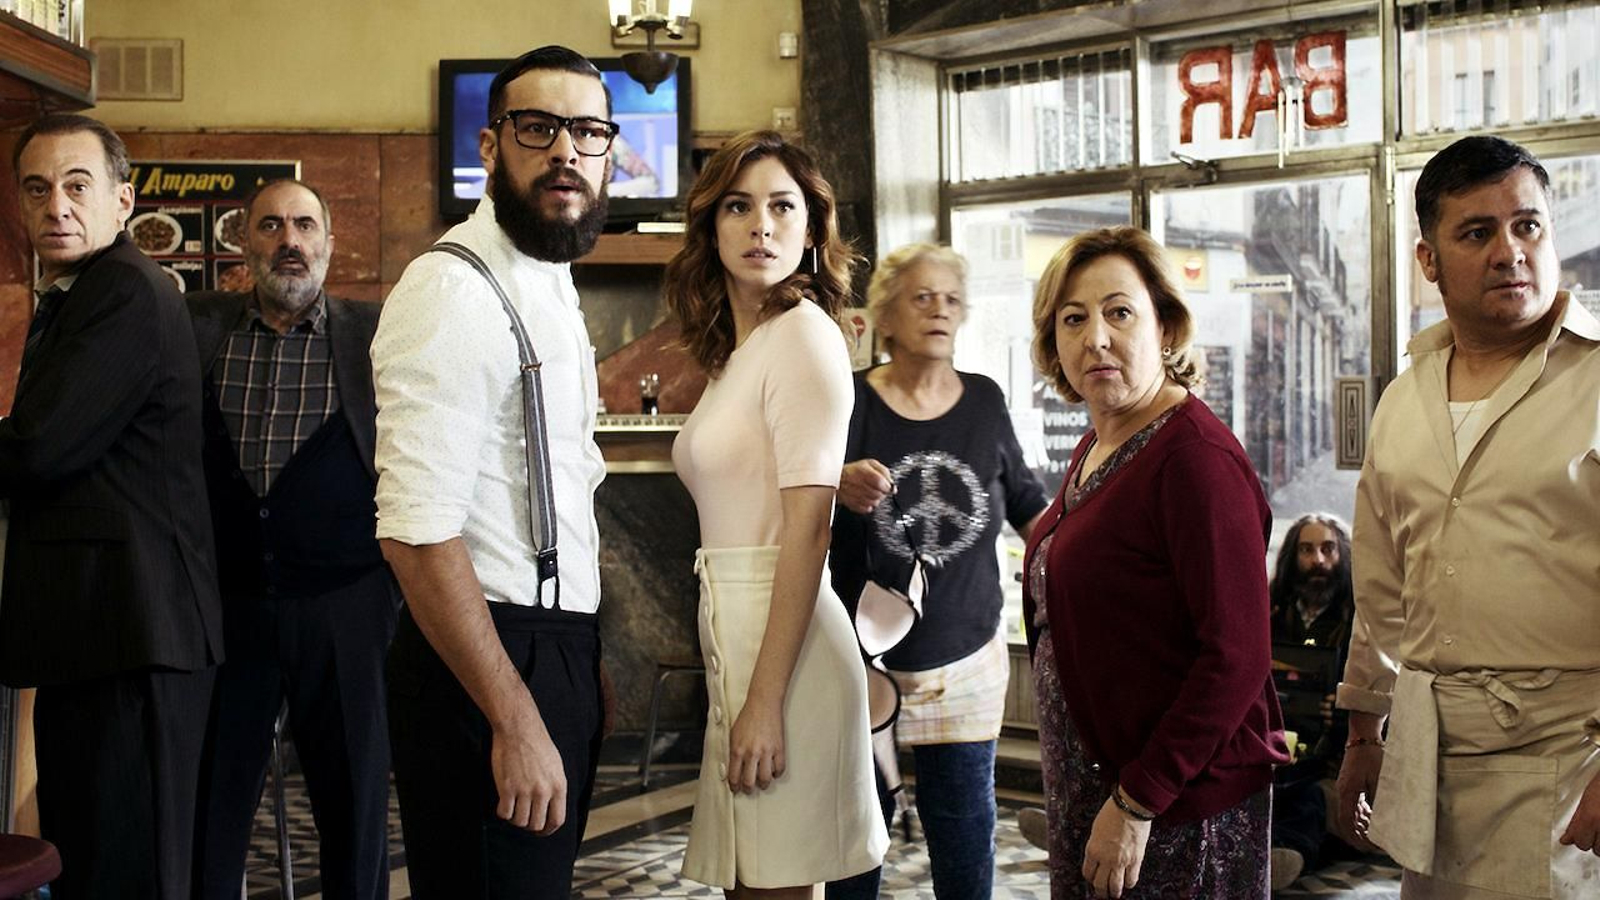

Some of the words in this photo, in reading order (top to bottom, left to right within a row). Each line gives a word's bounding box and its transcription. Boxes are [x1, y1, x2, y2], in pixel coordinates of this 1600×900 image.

[139, 167, 235, 197] Amparo
[1043, 411, 1088, 427] VINOS
[1044, 434, 1082, 450] VERM
